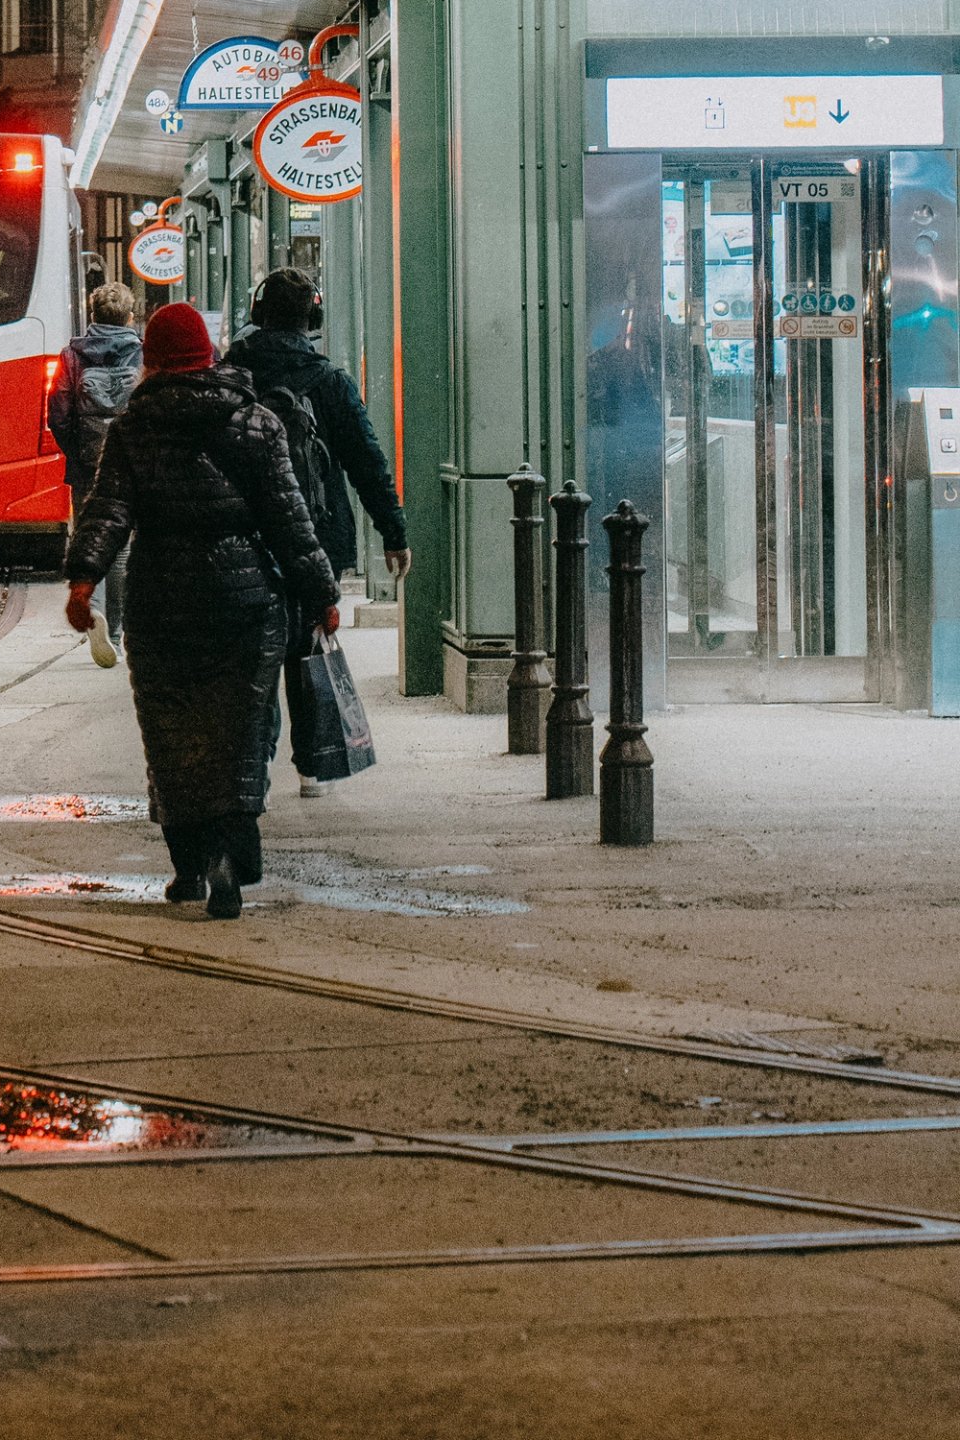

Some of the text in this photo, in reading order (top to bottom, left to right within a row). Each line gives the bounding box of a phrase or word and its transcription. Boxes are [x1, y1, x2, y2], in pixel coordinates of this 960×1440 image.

[212, 48, 284, 73] AUTOB
[279, 46, 302, 61] 46
[257, 67, 280, 82] 49
[198, 86, 294, 100] HALTESTELL
[148, 98, 166, 108] 48A
[780, 183, 828, 197] VT 05
